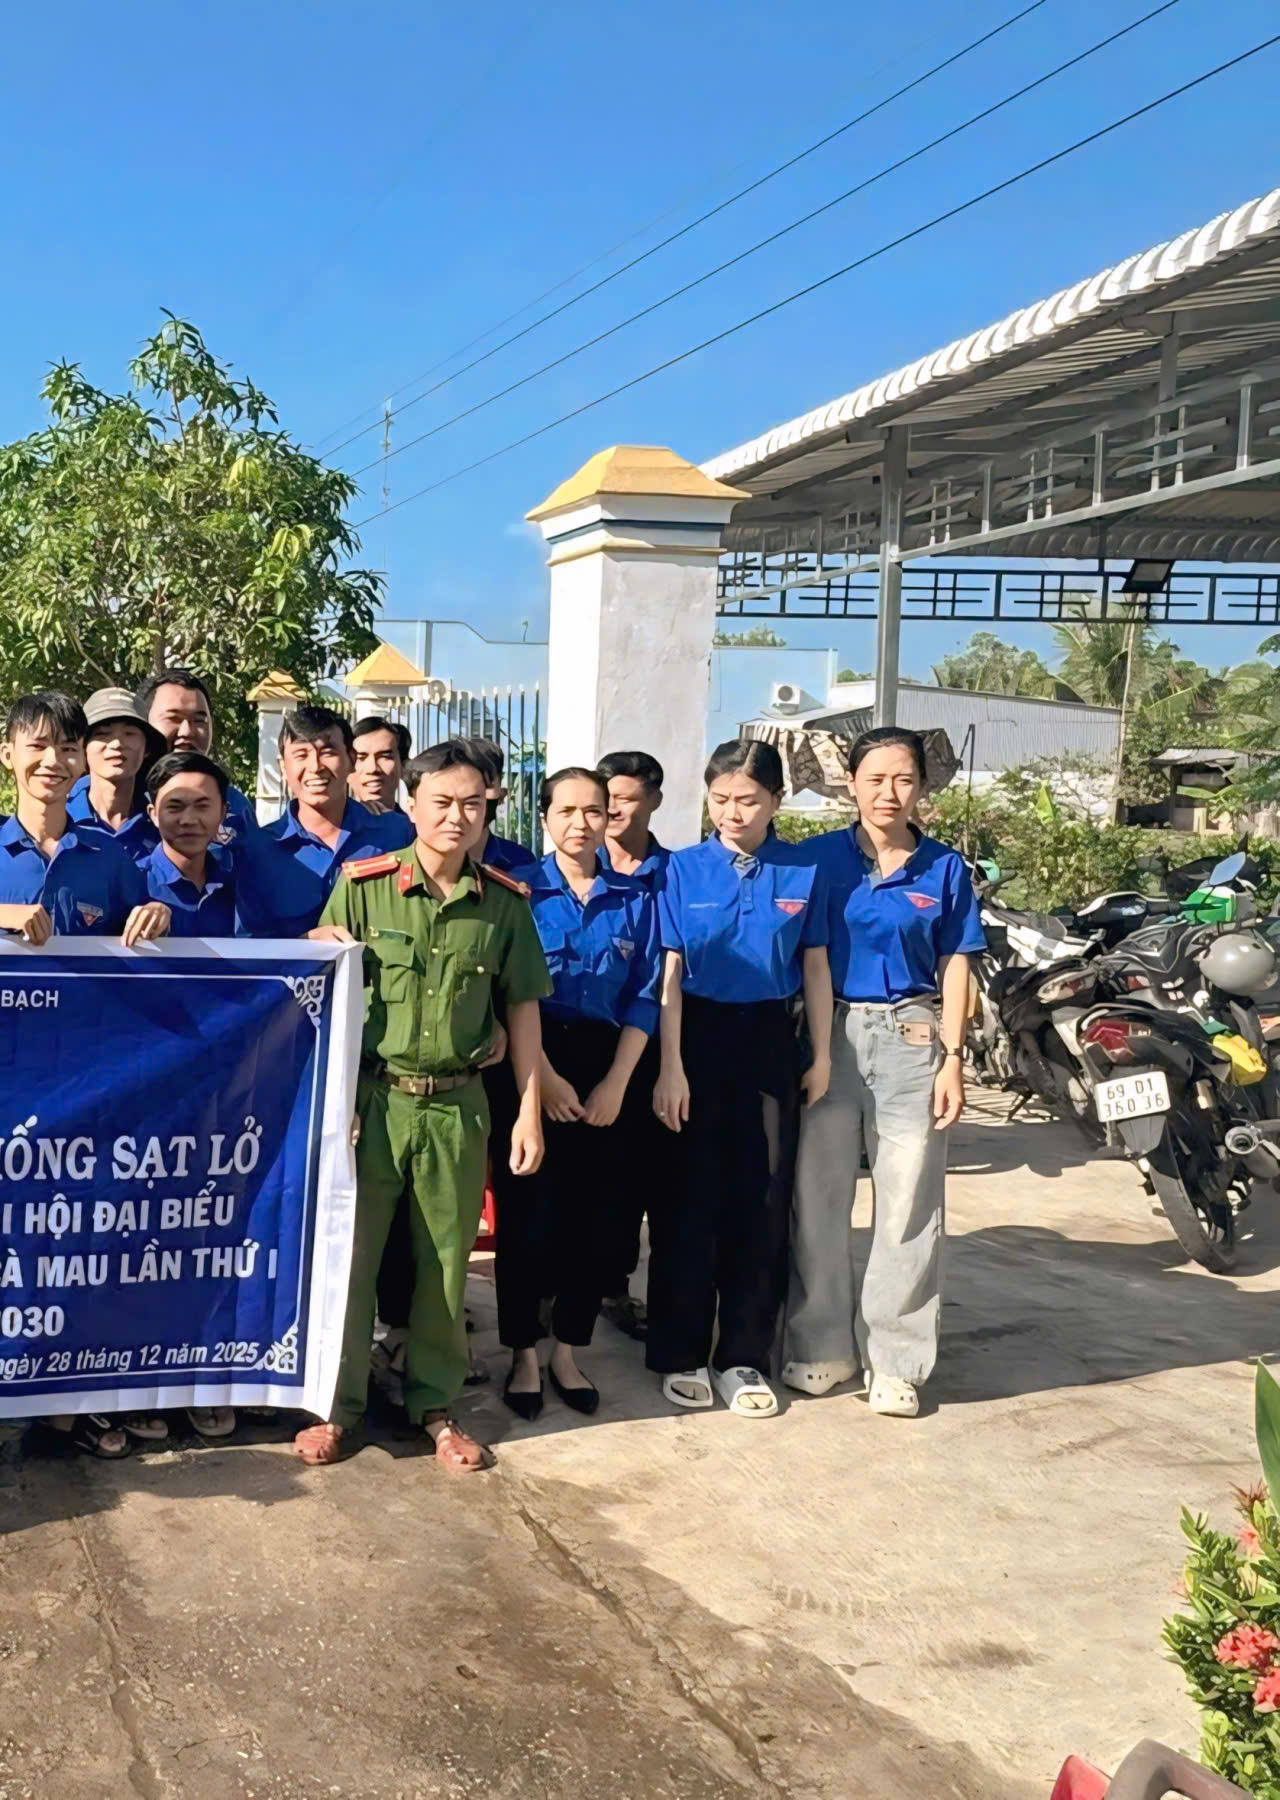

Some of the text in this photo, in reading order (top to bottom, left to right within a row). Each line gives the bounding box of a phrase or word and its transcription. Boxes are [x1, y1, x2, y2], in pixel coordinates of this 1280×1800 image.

[1, 990, 58, 1010] BẠCH
[112, 1136, 196, 1189] SẠT
[208, 1116, 262, 1175] LỞ
[25, 1193, 82, 1240] HỘI
[93, 1200, 149, 1237] ĐẠI
[161, 1180, 234, 1229] BIỂU
[37, 1255, 108, 1287] MAU
[120, 1239, 182, 1283] LẦN
[192, 1238, 260, 1278] THỨ
[268, 1249, 277, 1279] I
[47, 1351, 71, 1372] 28
[76, 1348, 131, 1376] tháng
[140, 1345, 161, 1365] 12
[165, 1344, 207, 1364] năm
[212, 1342, 260, 1363] 2025
